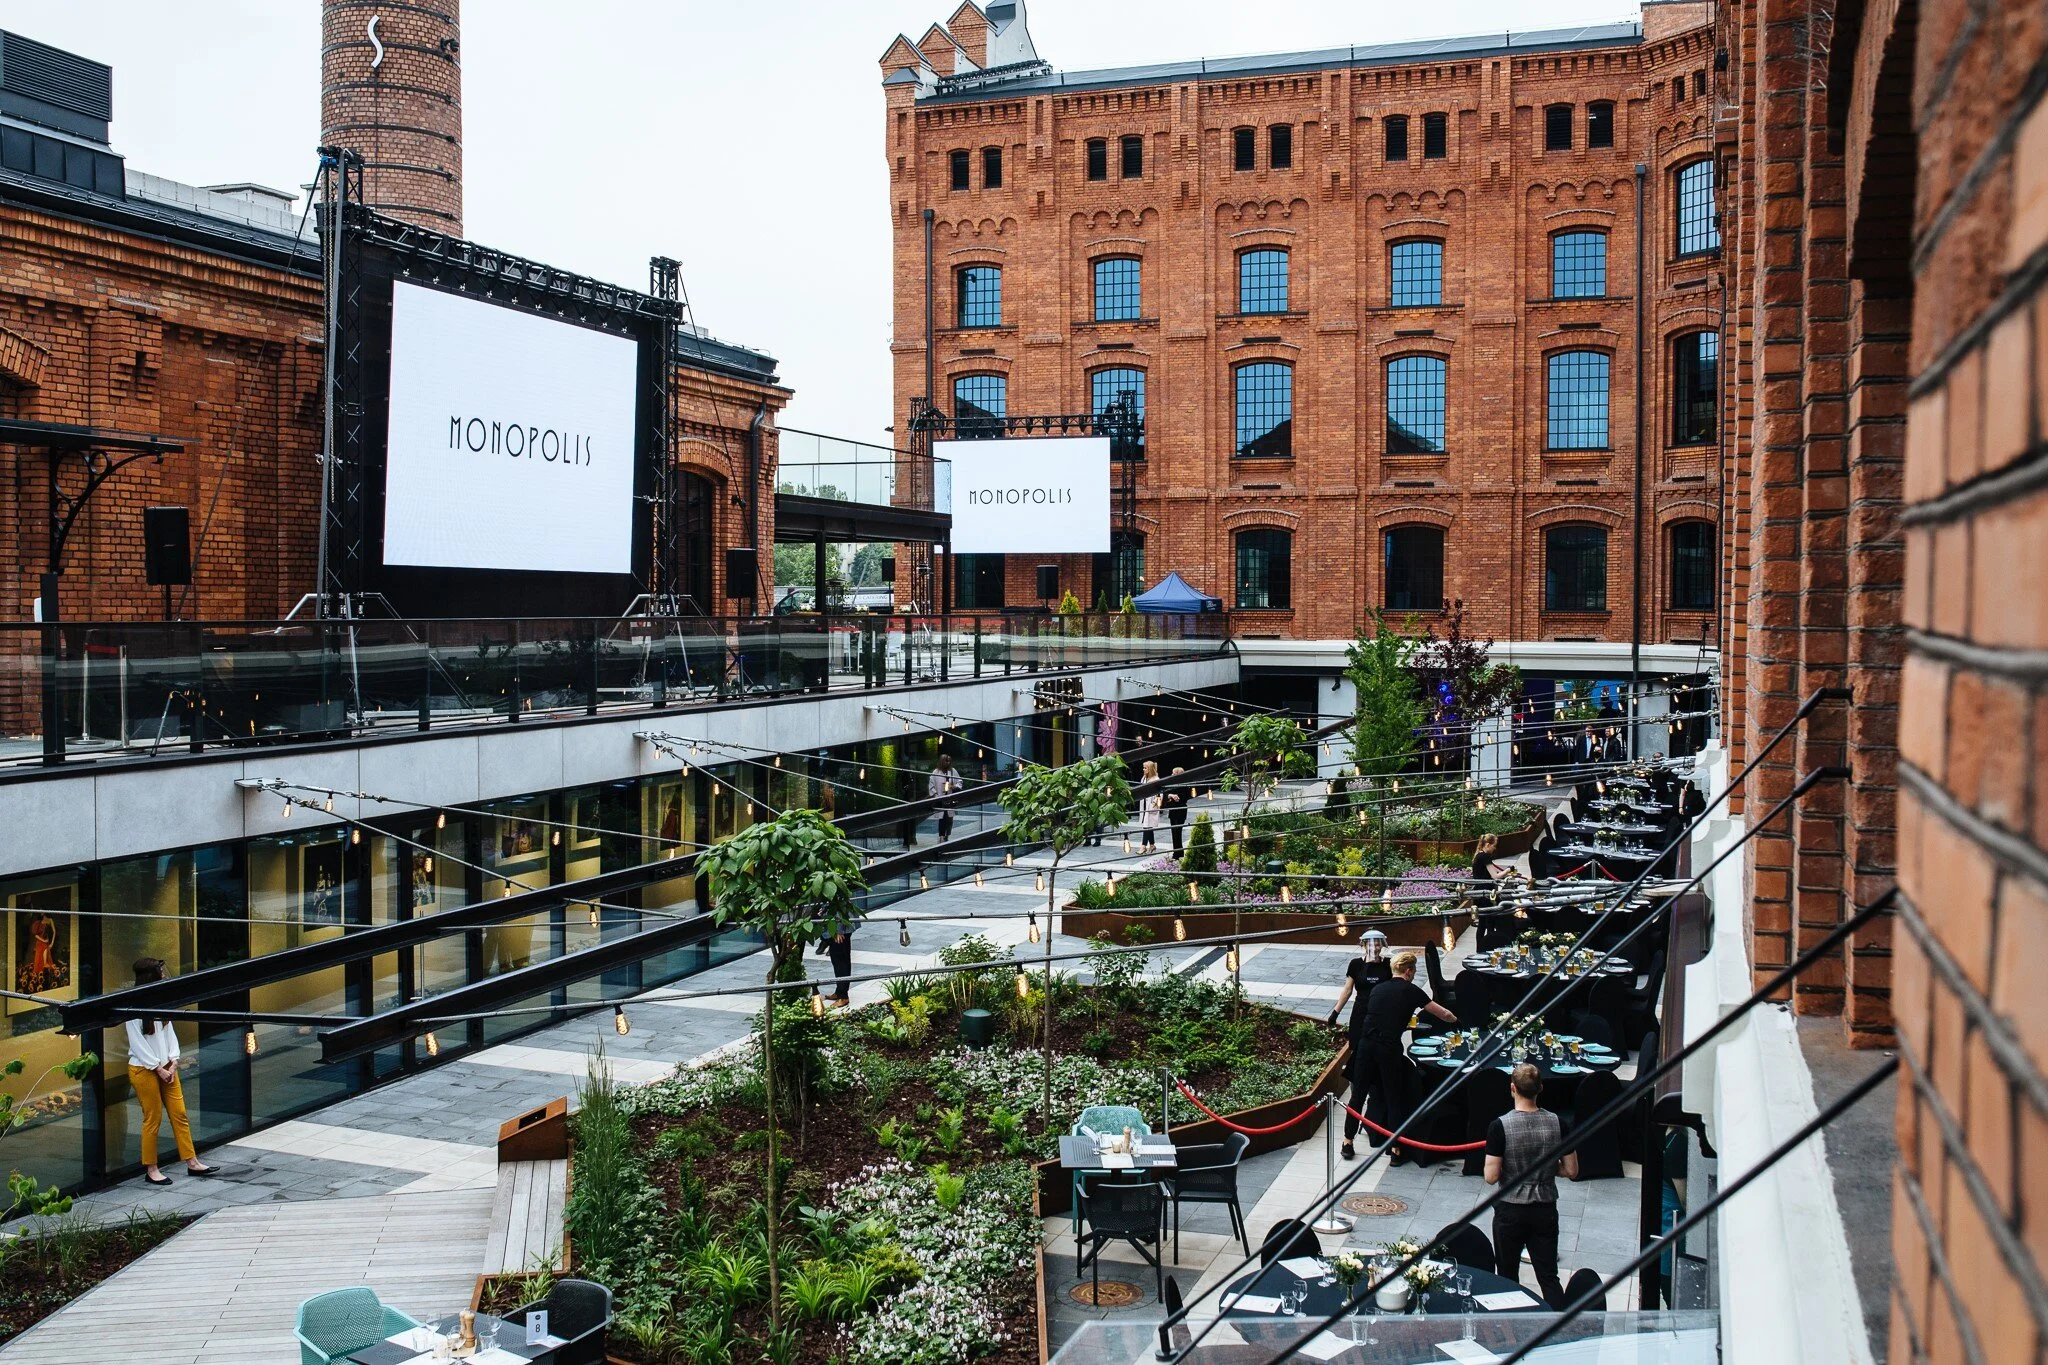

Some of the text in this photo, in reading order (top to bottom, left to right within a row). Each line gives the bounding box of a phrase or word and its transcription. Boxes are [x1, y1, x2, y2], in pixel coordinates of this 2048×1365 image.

[367, 14, 384, 68] S
[449, 415, 591, 467] MONOPOLIS
[969, 488, 1072, 505] MONOPOLIS
[535, 1323, 541, 1333] 8
